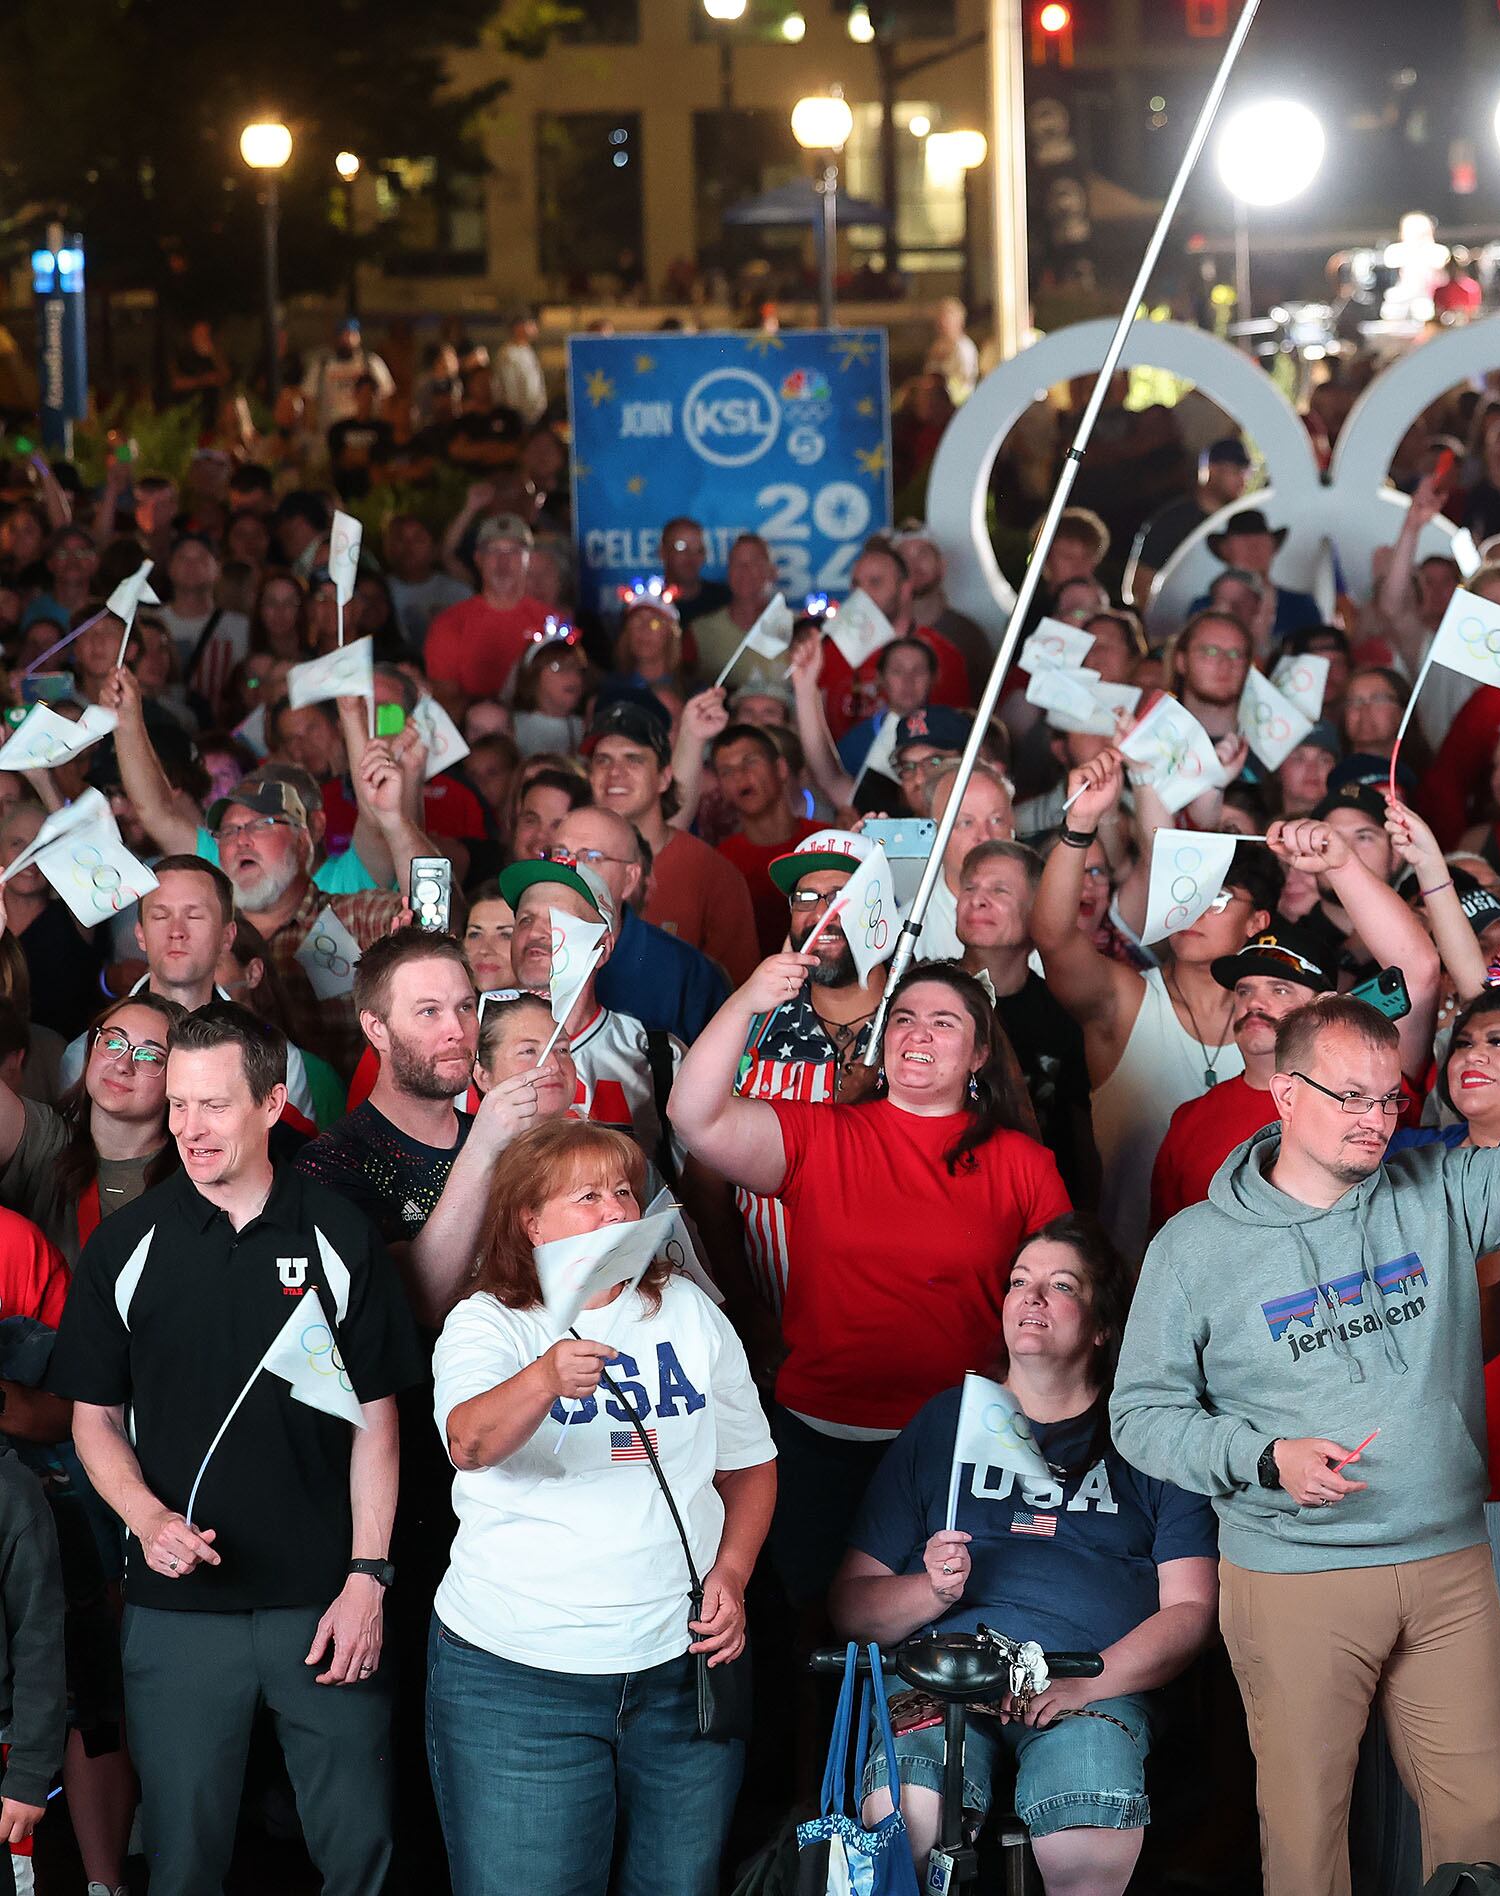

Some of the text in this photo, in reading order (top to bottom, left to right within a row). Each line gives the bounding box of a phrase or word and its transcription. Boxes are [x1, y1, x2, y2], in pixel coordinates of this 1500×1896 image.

[620, 400, 772, 438] JOIN KSL
[756, 483, 871, 542] 20
[276, 1257, 309, 1288] U
[282, 1287, 305, 1296] UTAH
[1287, 1296, 1427, 1362] jerusalem
